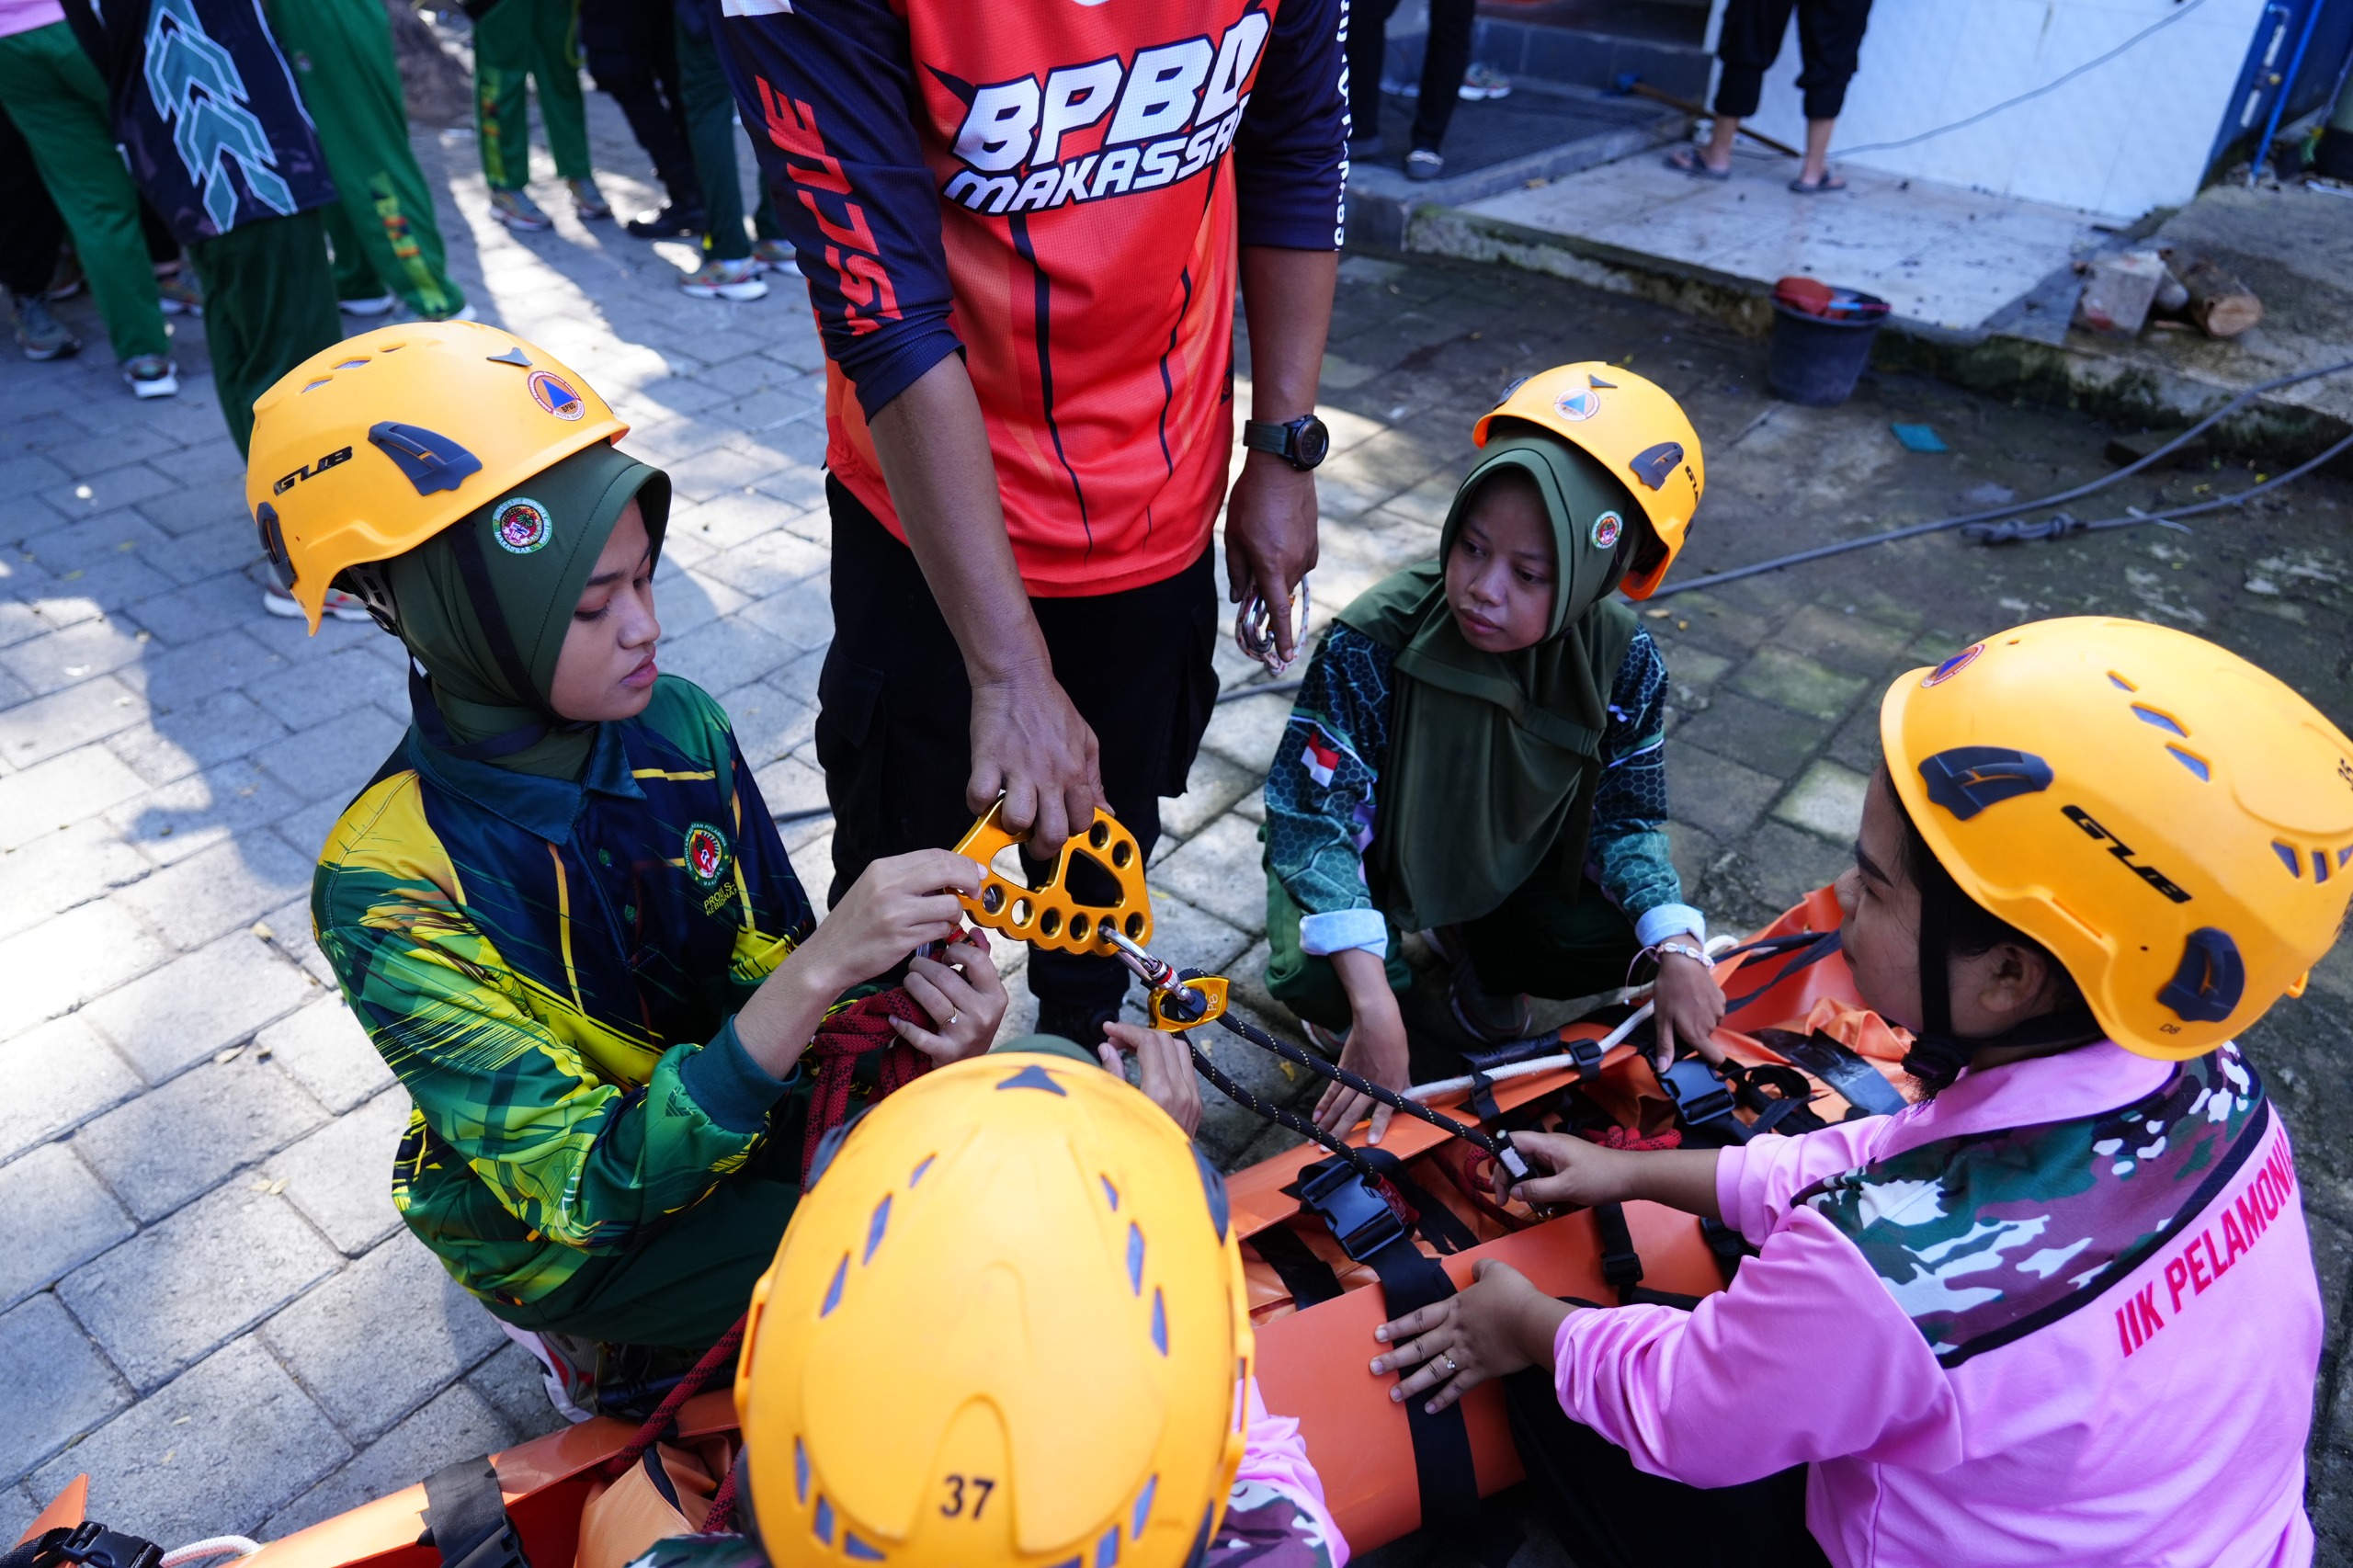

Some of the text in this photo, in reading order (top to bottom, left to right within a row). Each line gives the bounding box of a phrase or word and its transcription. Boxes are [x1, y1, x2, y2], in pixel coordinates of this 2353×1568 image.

[949, 10, 1271, 173] BPBD
[755, 74, 904, 336] SCUE
[2115, 1280, 2165, 1358] IIK
[940, 1473, 996, 1521] 37
